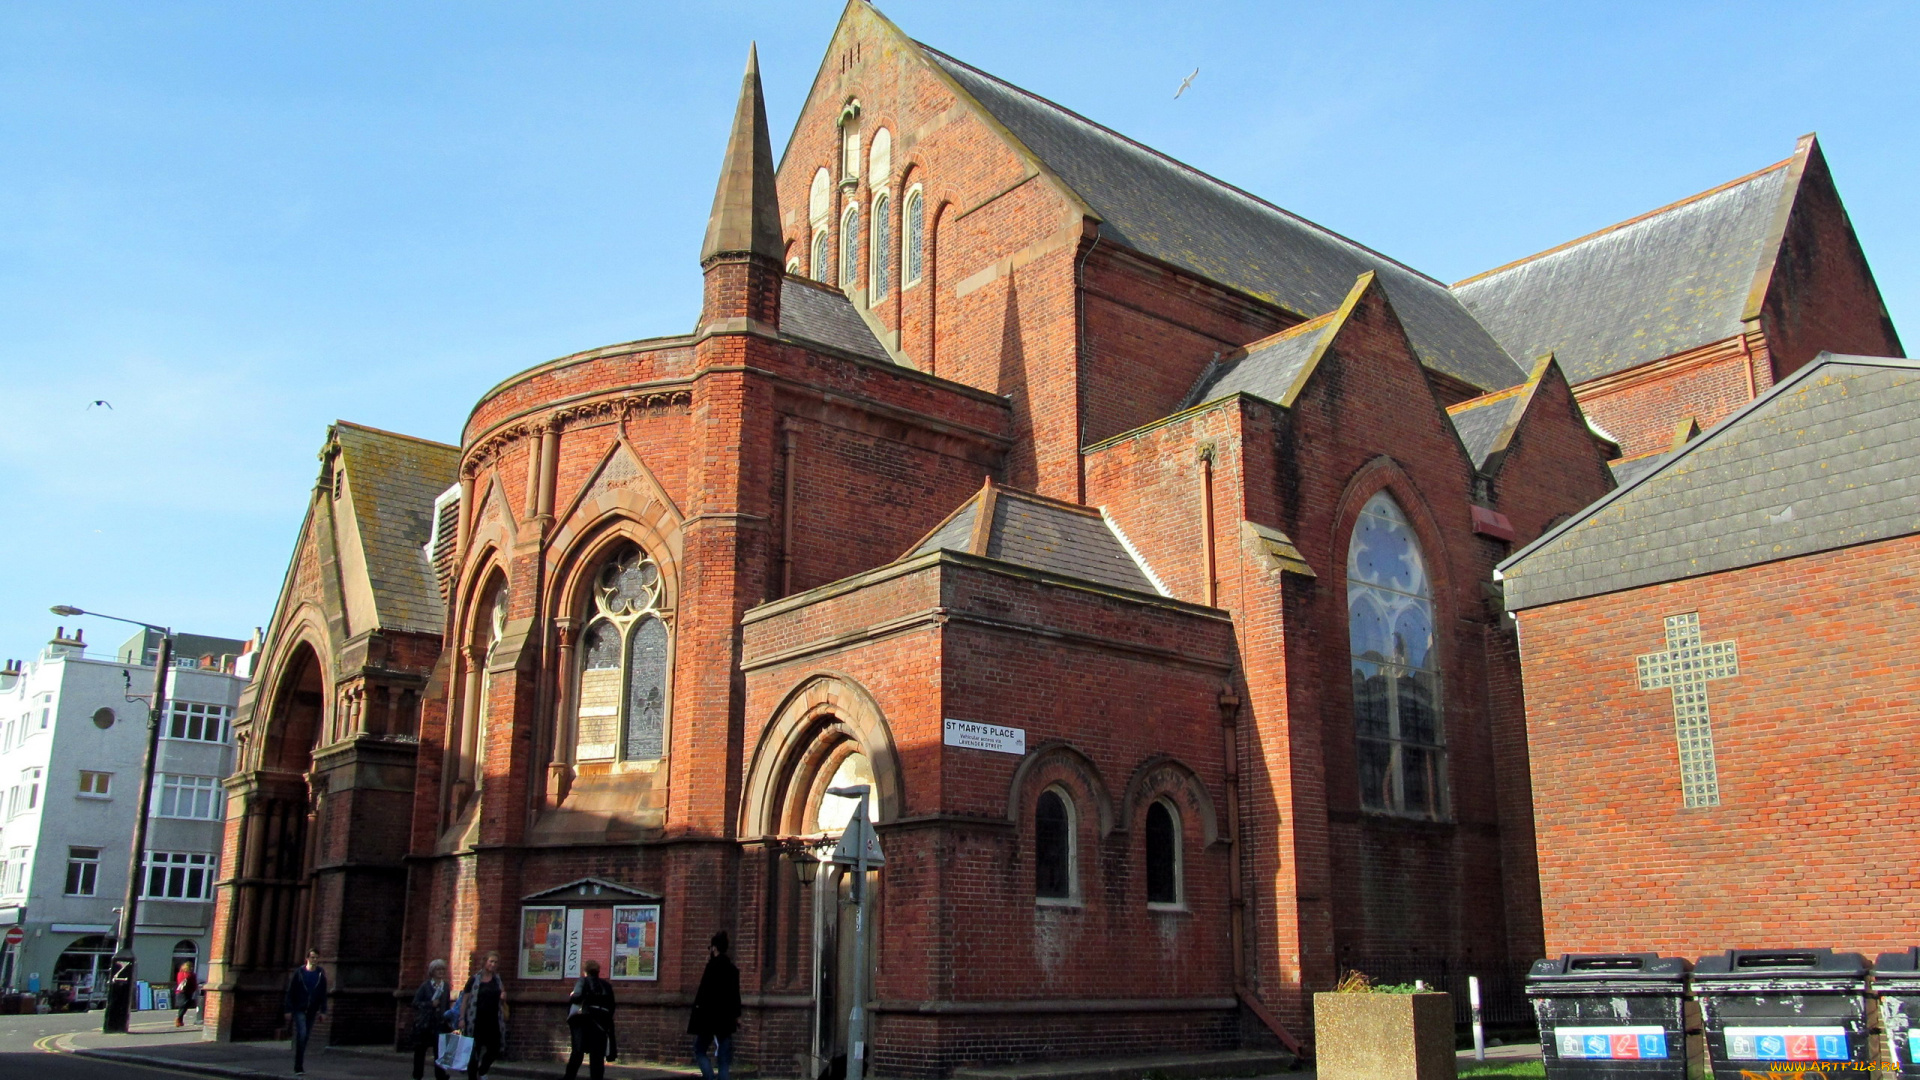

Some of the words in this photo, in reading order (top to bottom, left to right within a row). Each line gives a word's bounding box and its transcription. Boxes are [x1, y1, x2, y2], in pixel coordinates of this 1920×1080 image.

[946, 721, 956, 730] ST
[959, 723, 988, 735] MARY'S
[990, 728, 1014, 738] PLACE
[568, 930, 578, 971] MARY'S
